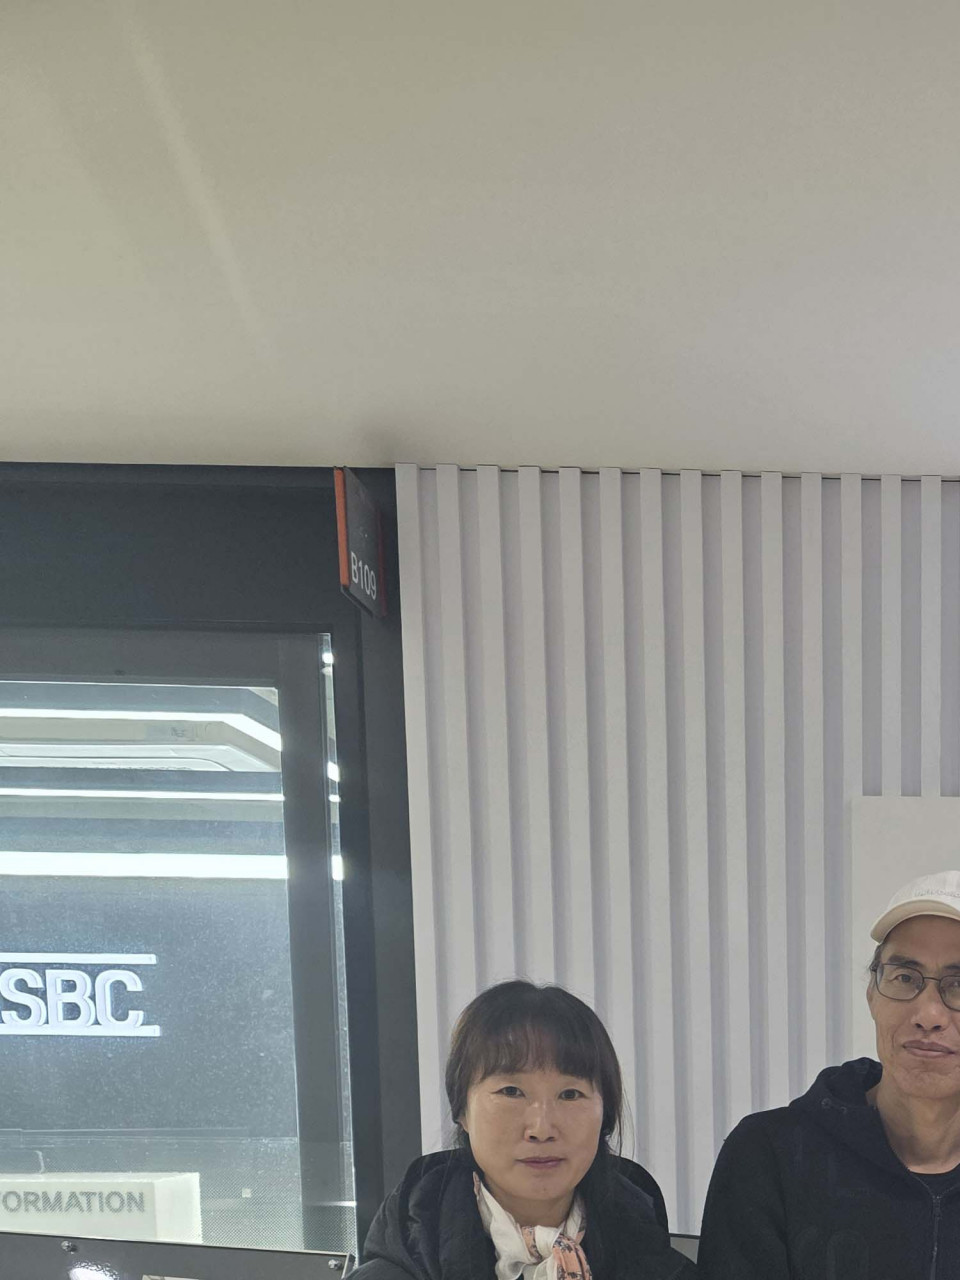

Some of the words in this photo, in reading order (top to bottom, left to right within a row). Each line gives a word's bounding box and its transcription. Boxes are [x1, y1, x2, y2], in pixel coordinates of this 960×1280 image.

[351, 551, 377, 601] B109
[0, 968, 144, 1026] SBC
[3, 1190, 145, 1214] ORMATION
